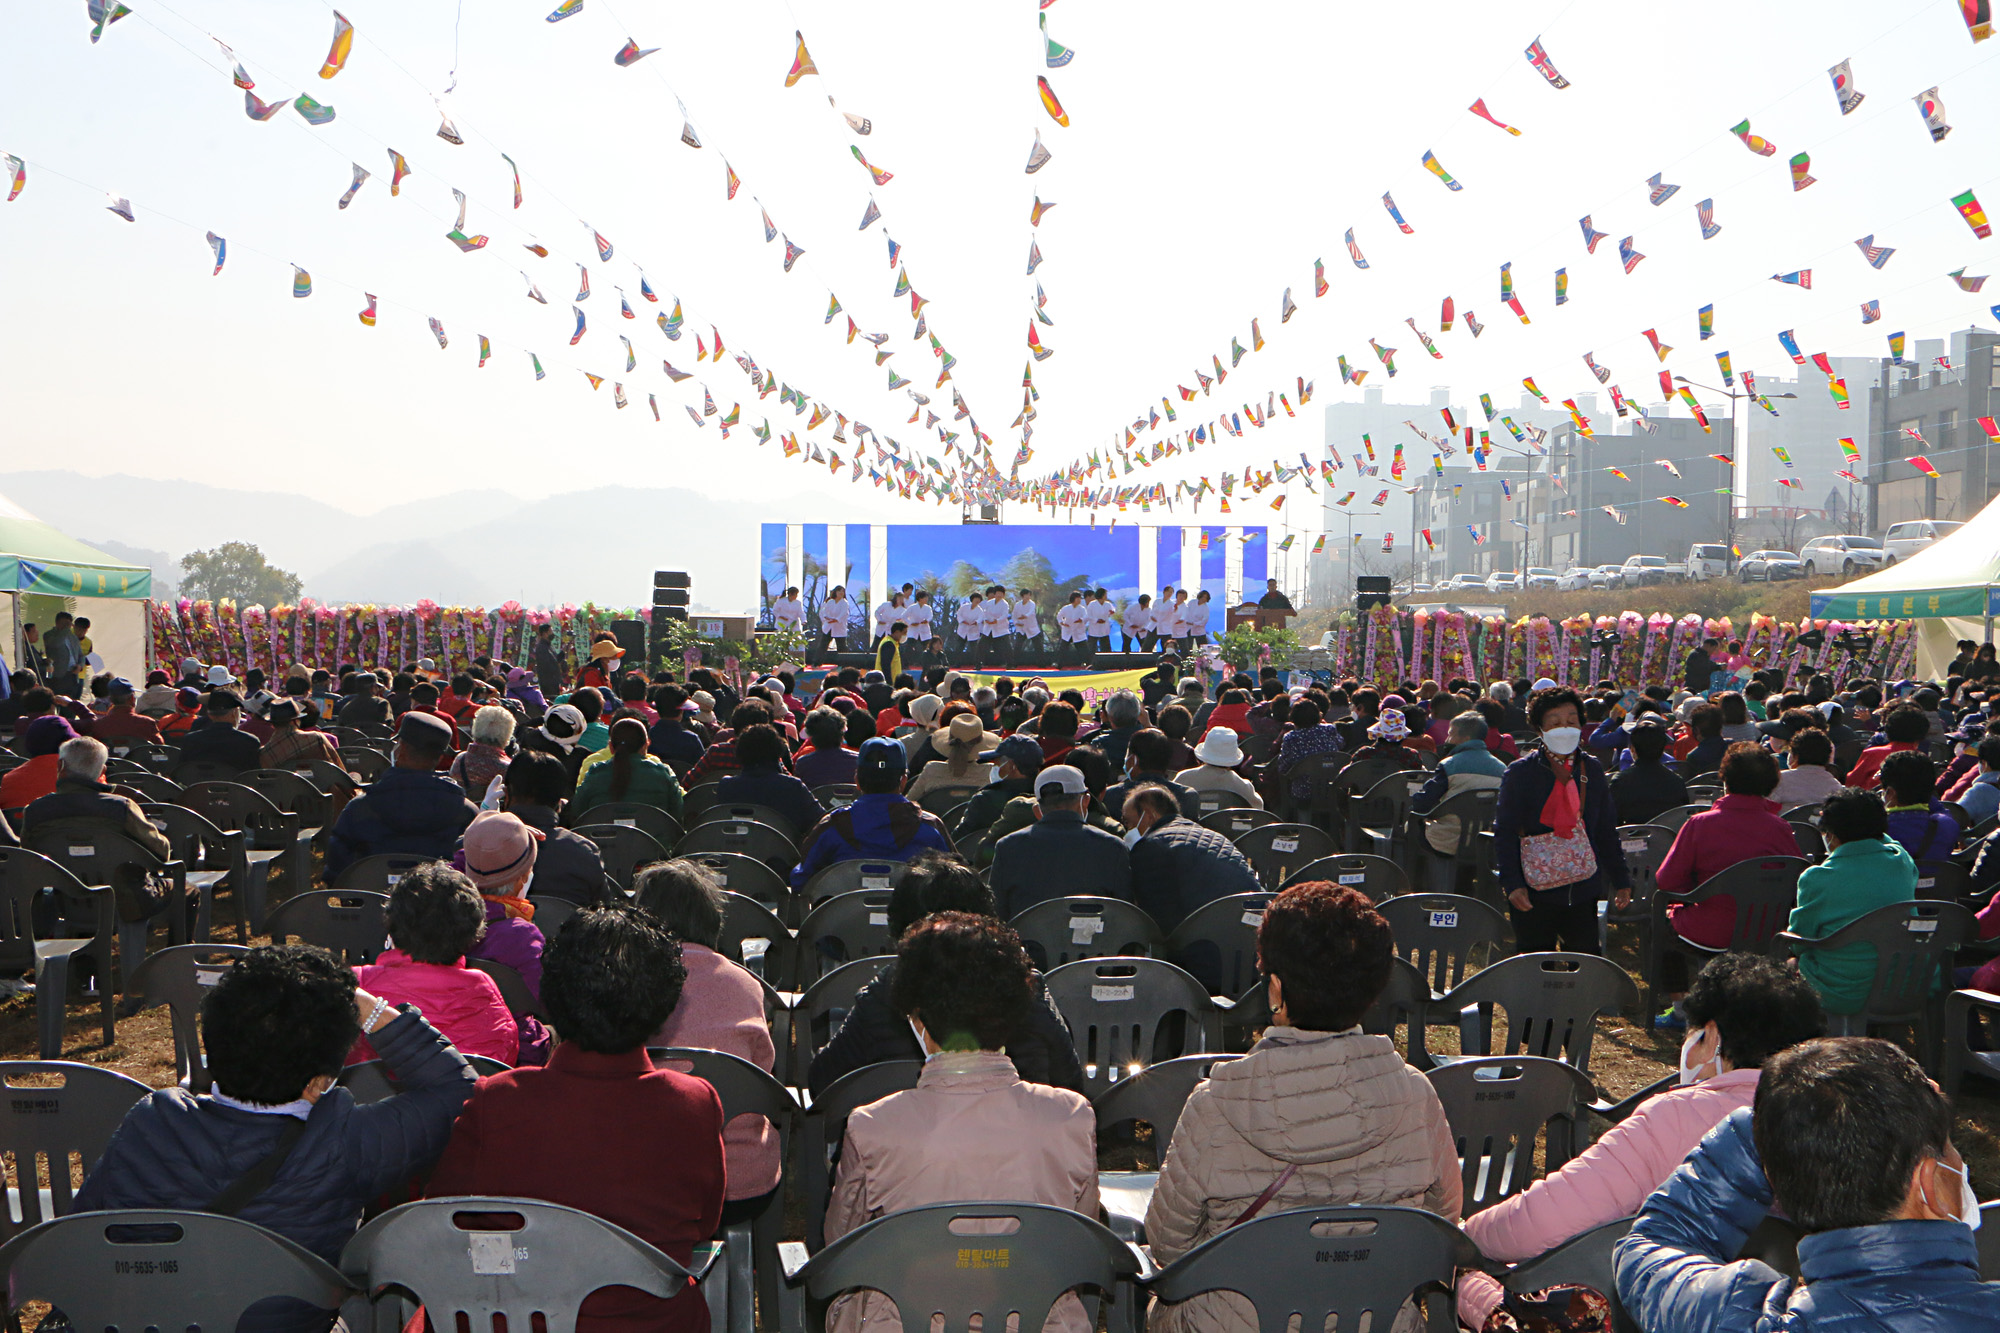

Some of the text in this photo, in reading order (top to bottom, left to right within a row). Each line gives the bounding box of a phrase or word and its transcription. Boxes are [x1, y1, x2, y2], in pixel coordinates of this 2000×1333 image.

[1857, 595, 1940, 616] 운영본부
[1433, 913, 1455, 925] 부안
[957, 1248, 1009, 1261] 렌탈마트
[115, 1260, 178, 1274] 010-5635-1065
